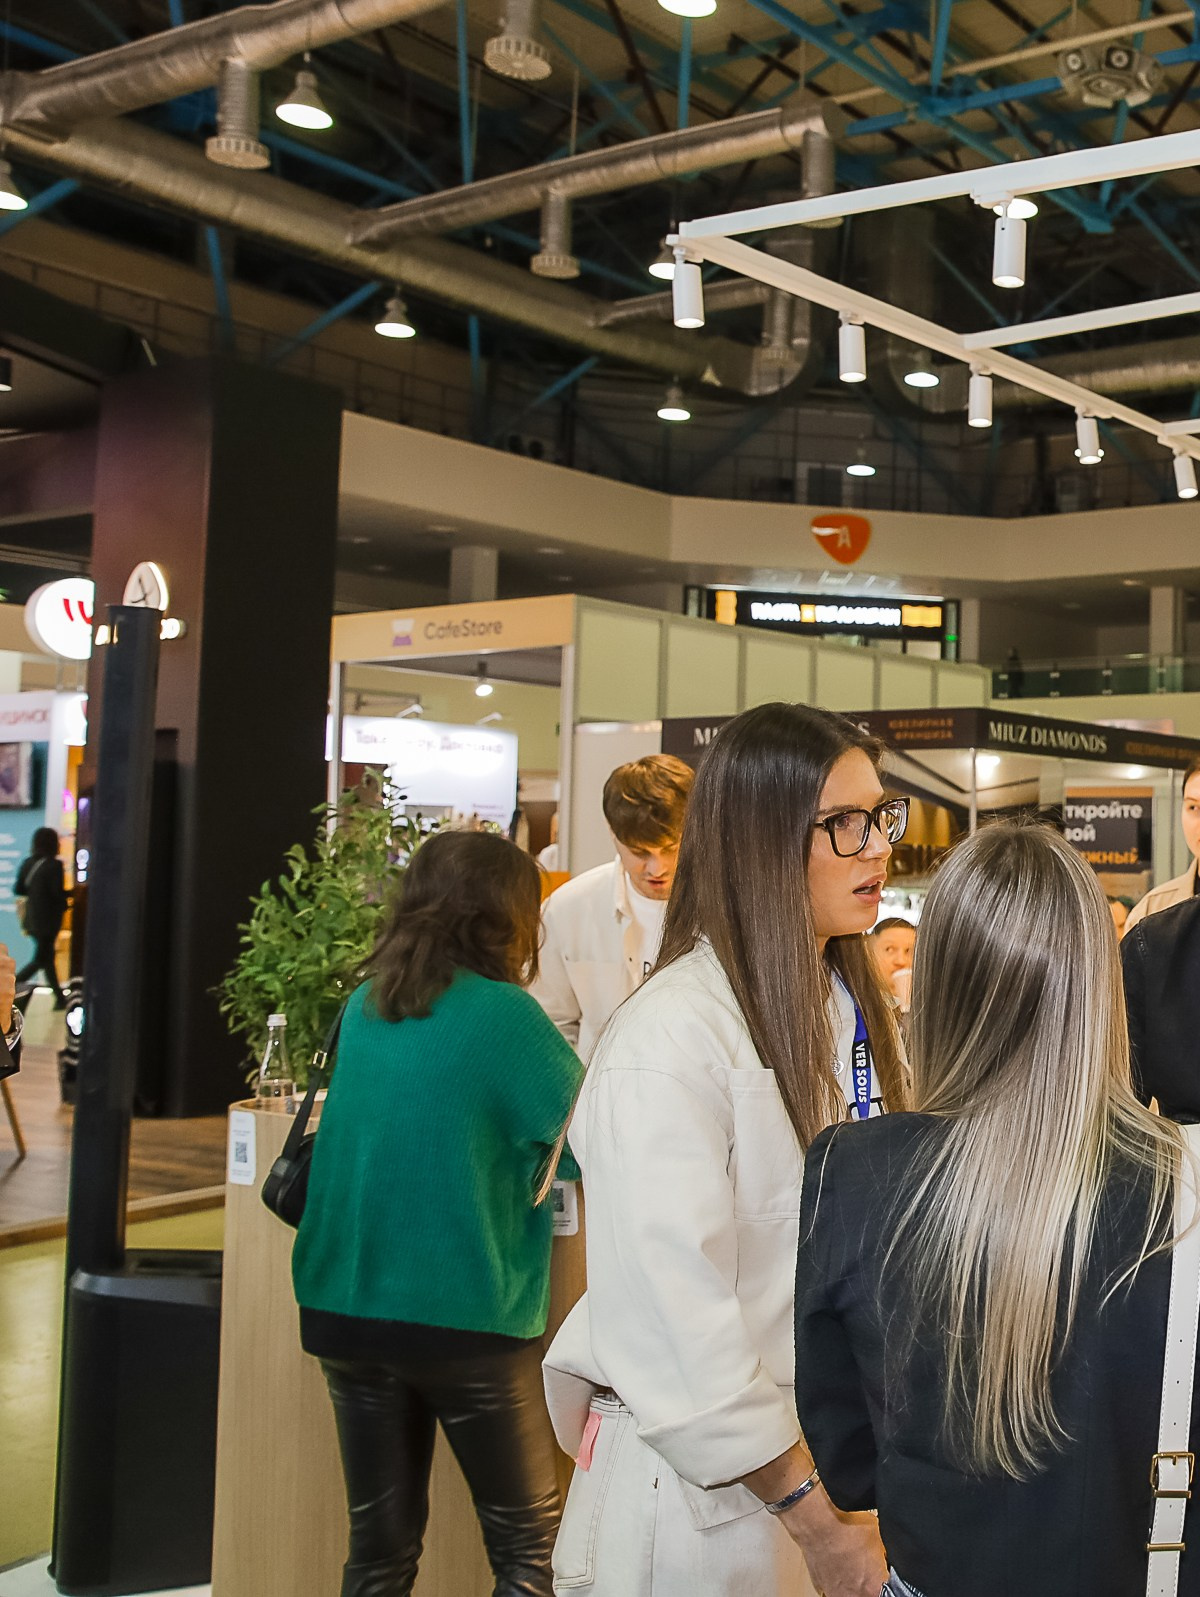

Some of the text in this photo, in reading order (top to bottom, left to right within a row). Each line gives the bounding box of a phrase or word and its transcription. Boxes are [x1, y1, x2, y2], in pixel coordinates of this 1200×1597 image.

[424, 619, 502, 640] CafeStore
[988, 721, 1107, 754] MIUZ DIAMONDS
[1065, 801, 1143, 822] ткройте
[1082, 847, 1139, 864] жный
